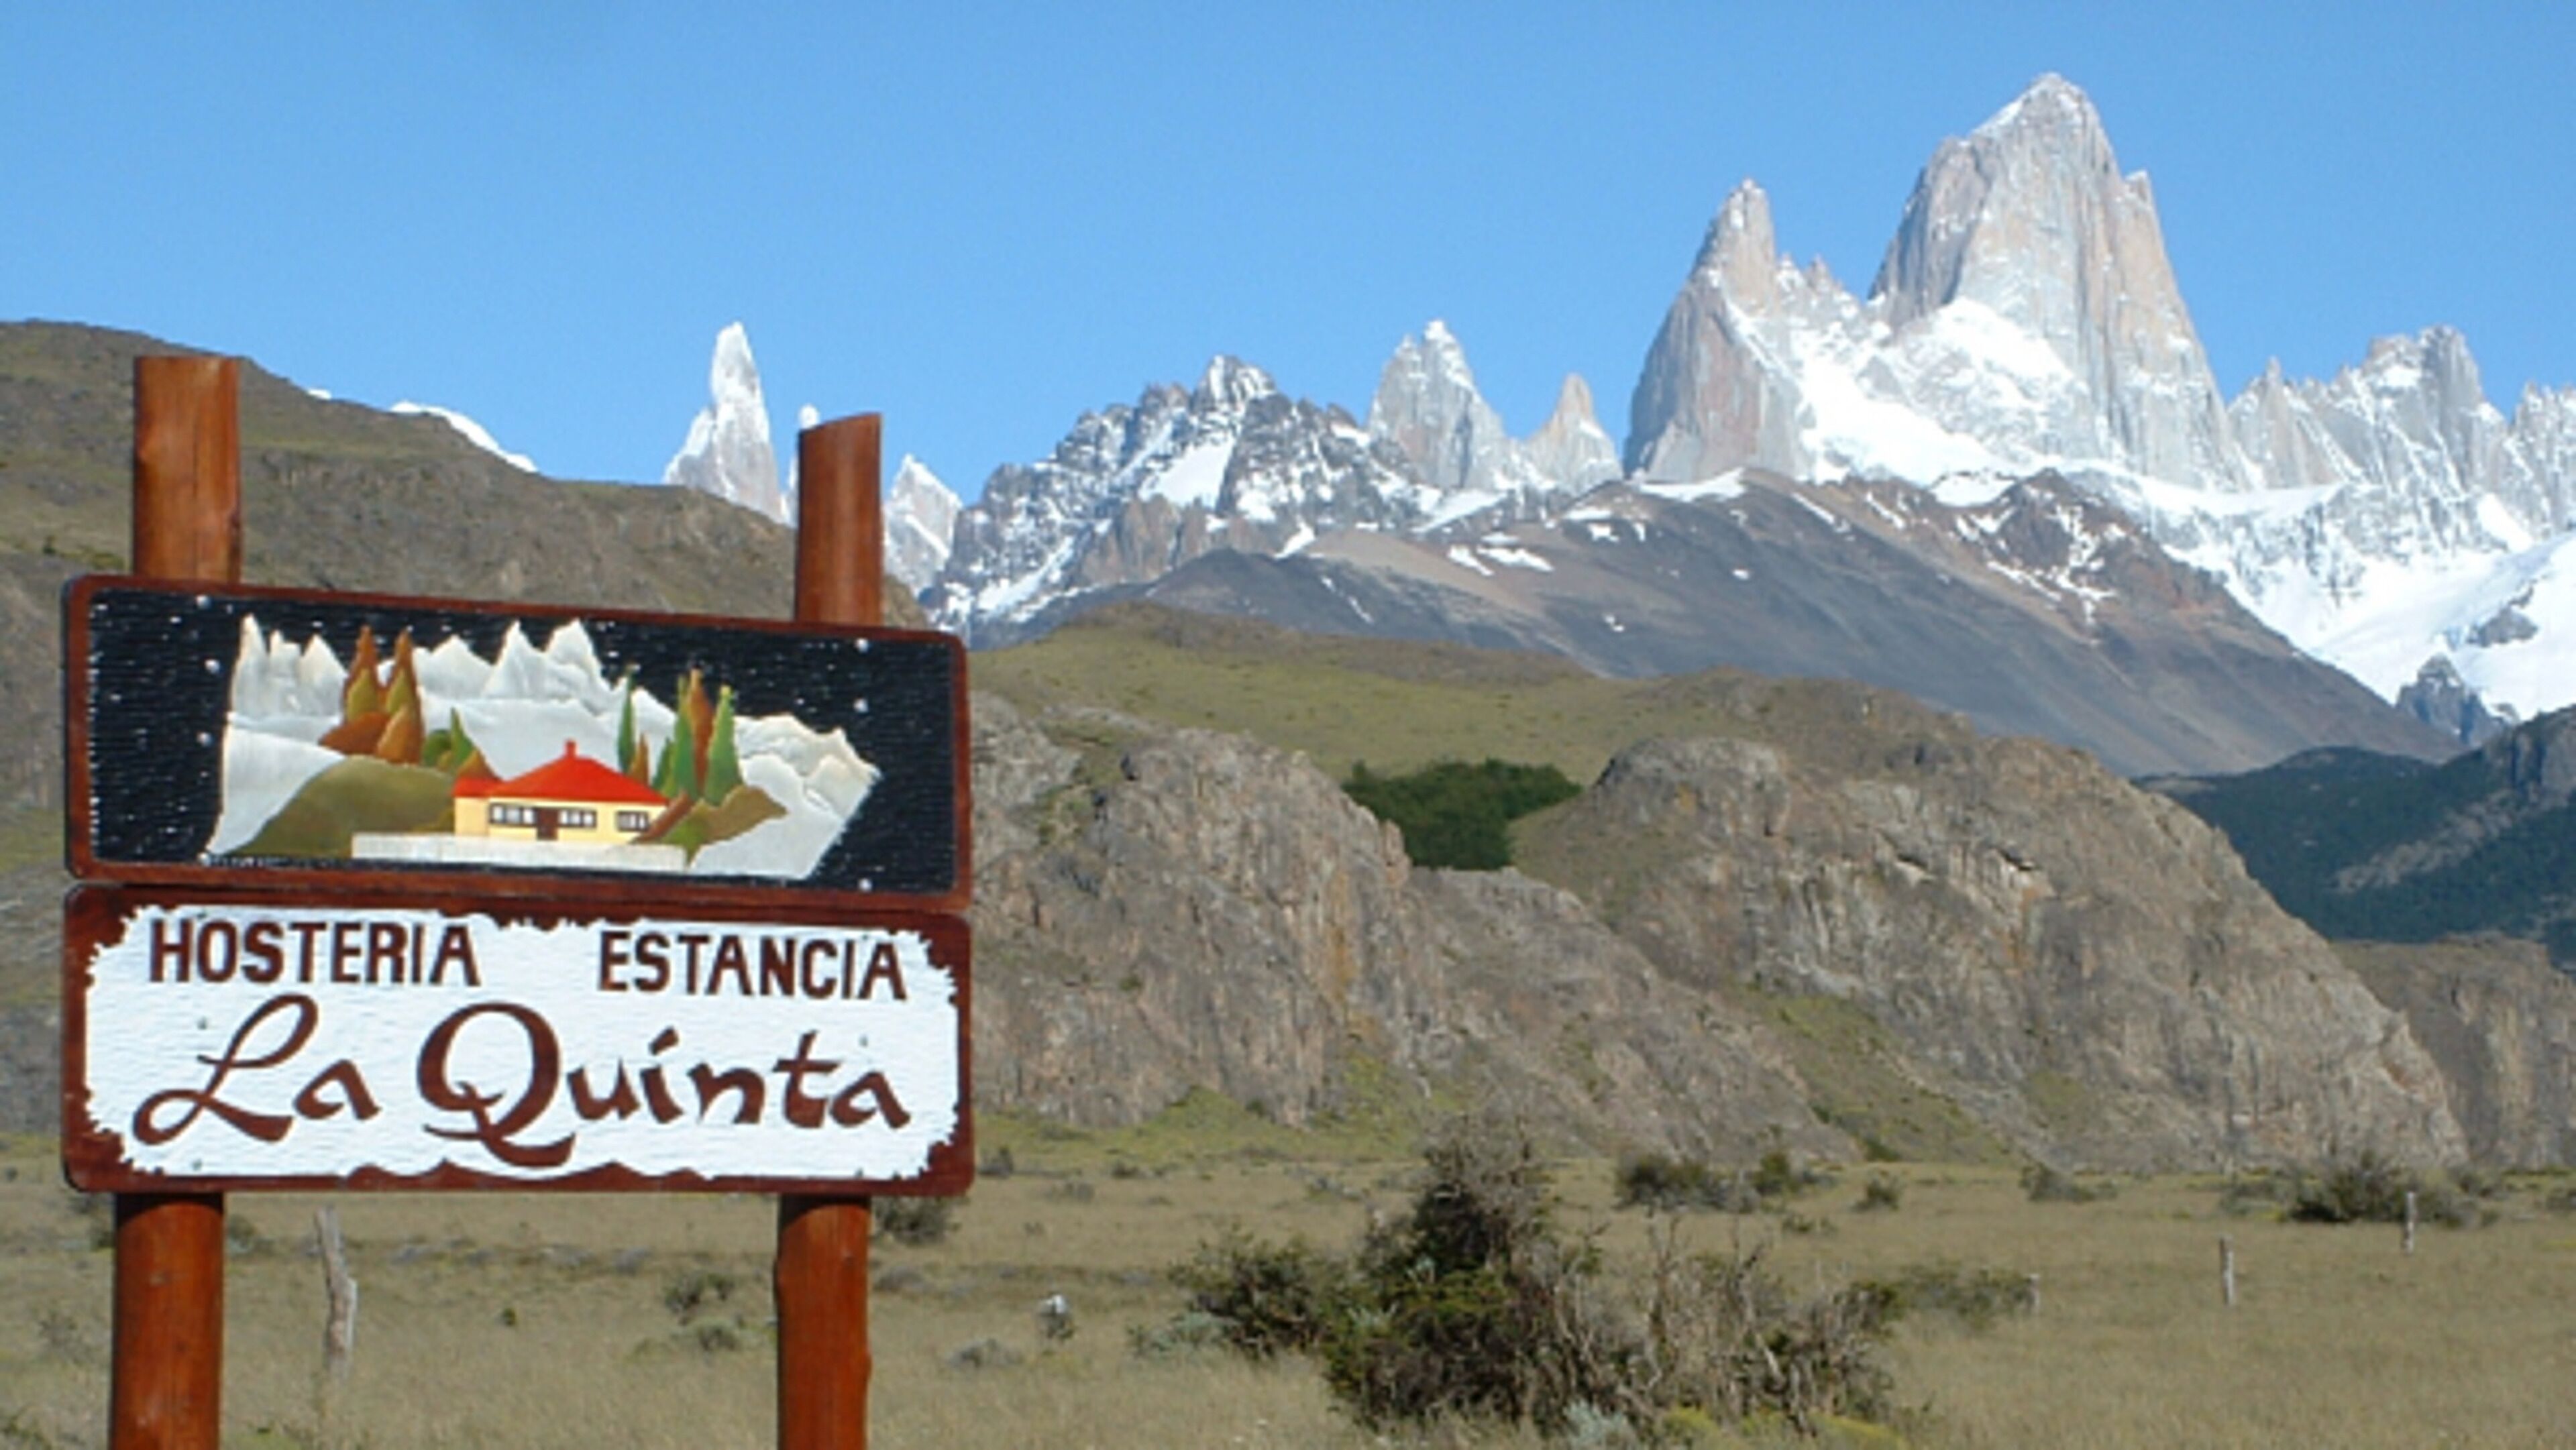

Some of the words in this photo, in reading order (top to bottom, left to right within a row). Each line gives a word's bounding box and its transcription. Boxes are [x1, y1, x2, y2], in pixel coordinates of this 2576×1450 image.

[149, 919, 481, 986] HOSTERIA
[598, 930, 907, 1000] ESTANCIA
[133, 993, 380, 1146] La
